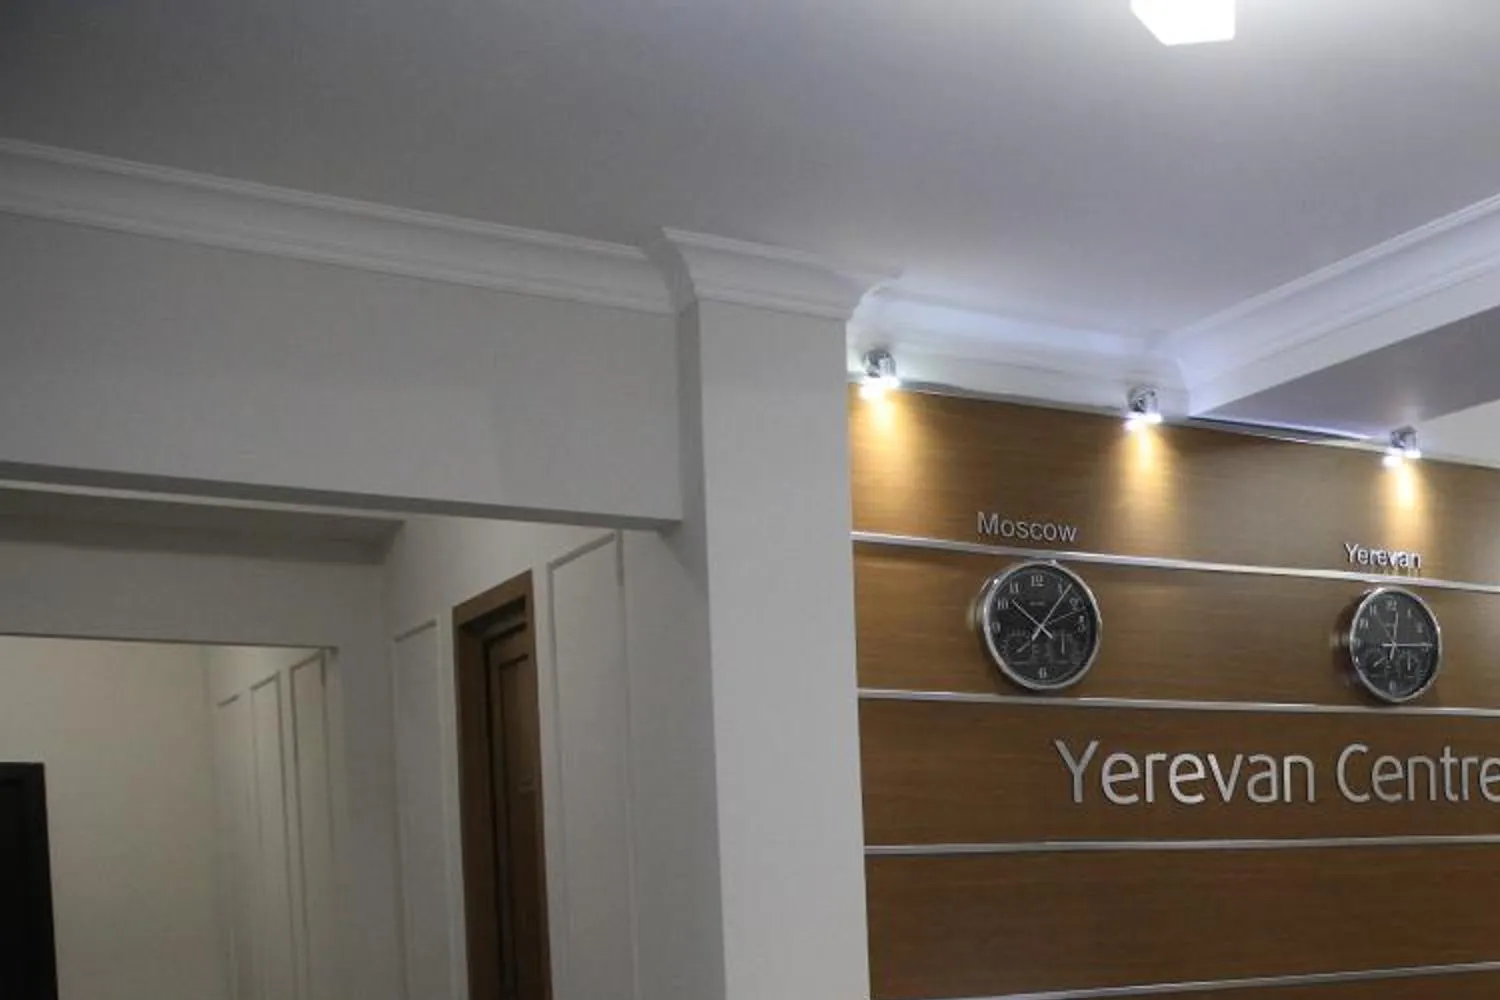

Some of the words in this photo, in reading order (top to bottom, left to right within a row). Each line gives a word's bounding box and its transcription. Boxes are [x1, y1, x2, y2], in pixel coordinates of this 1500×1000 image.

[977, 511, 1077, 542] Moscow
[1344, 543, 1421, 569] Yerevan
[1030, 575, 1045, 587] 12
[1054, 739, 1316, 805] Yerevan
